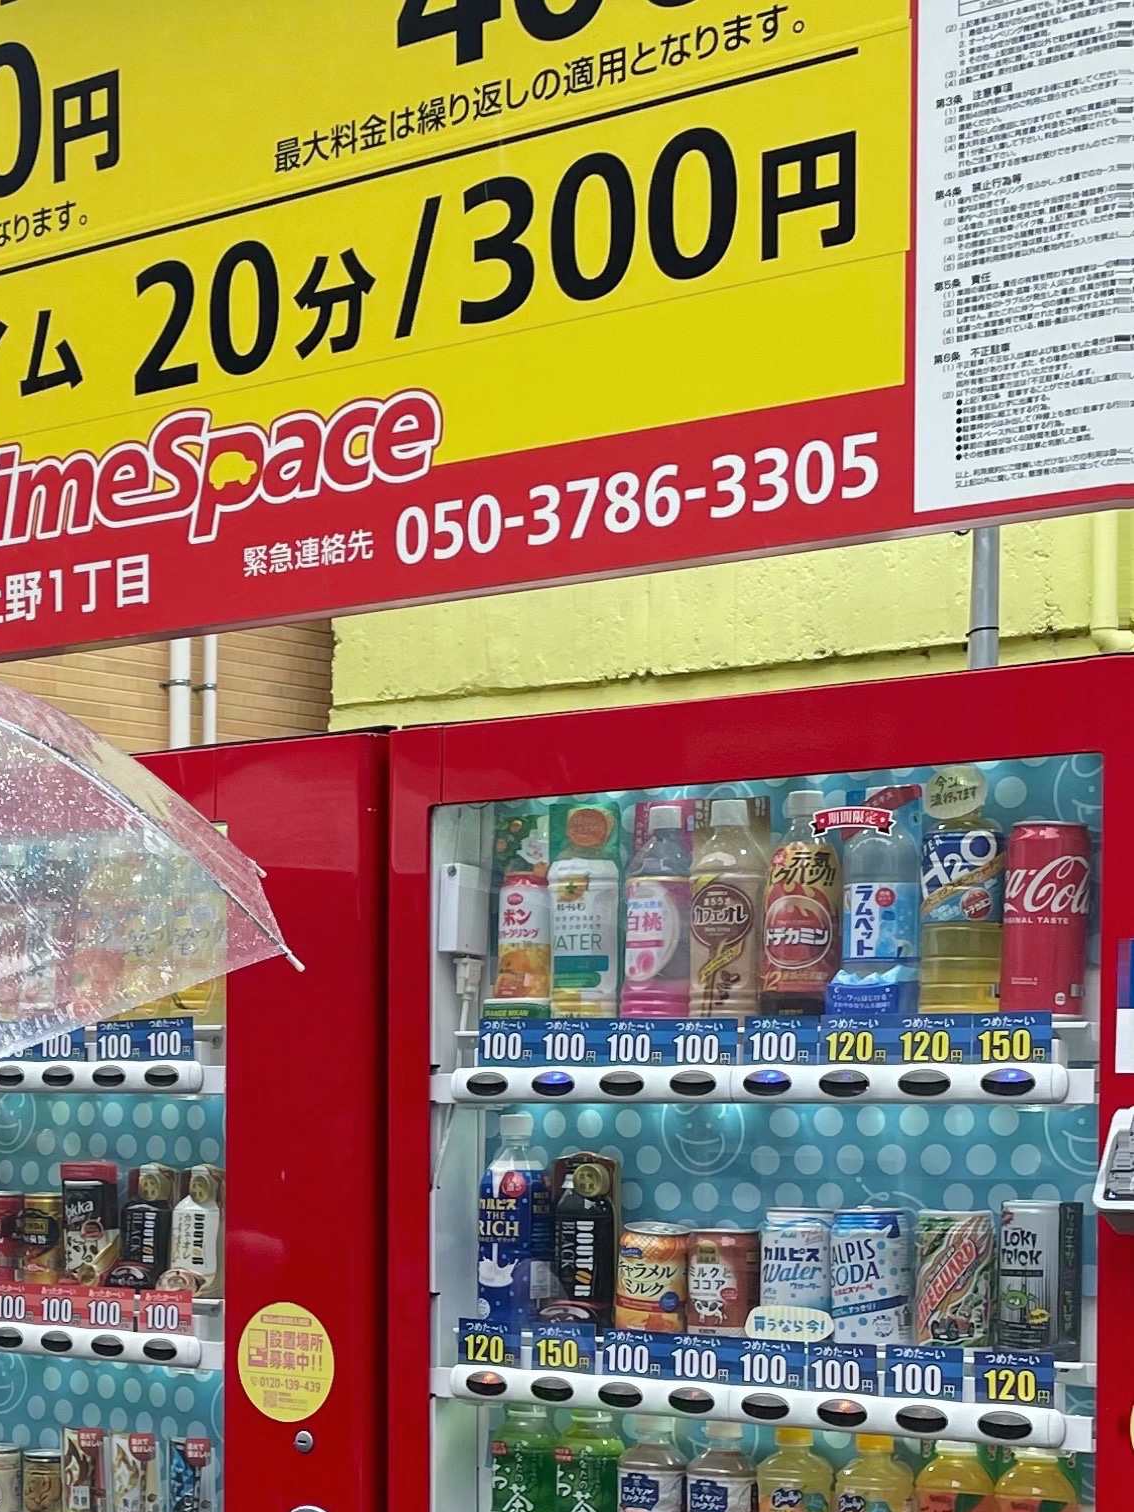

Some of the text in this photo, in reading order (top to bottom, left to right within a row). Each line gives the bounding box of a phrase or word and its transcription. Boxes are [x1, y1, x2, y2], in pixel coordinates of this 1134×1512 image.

[274, 3, 807, 172] 最大料金は繰り返しの適用となります。
[243, 531, 374, 577] 緊急連絡先
[395, 432, 880, 565] 050-3786-3305
[1037, 916, 1069, 925] TASTE
[554, 933, 602, 951] ATER
[486, 1211, 506, 1220] THE
[560, 1221, 575, 1270] BLACK
[763, 1263, 822, 1283] Water
[694, 1279, 725, 1290] ココア
[269, 1329, 324, 1351] 設置場所
[259, 1377, 321, 1393] 0120-139-439
